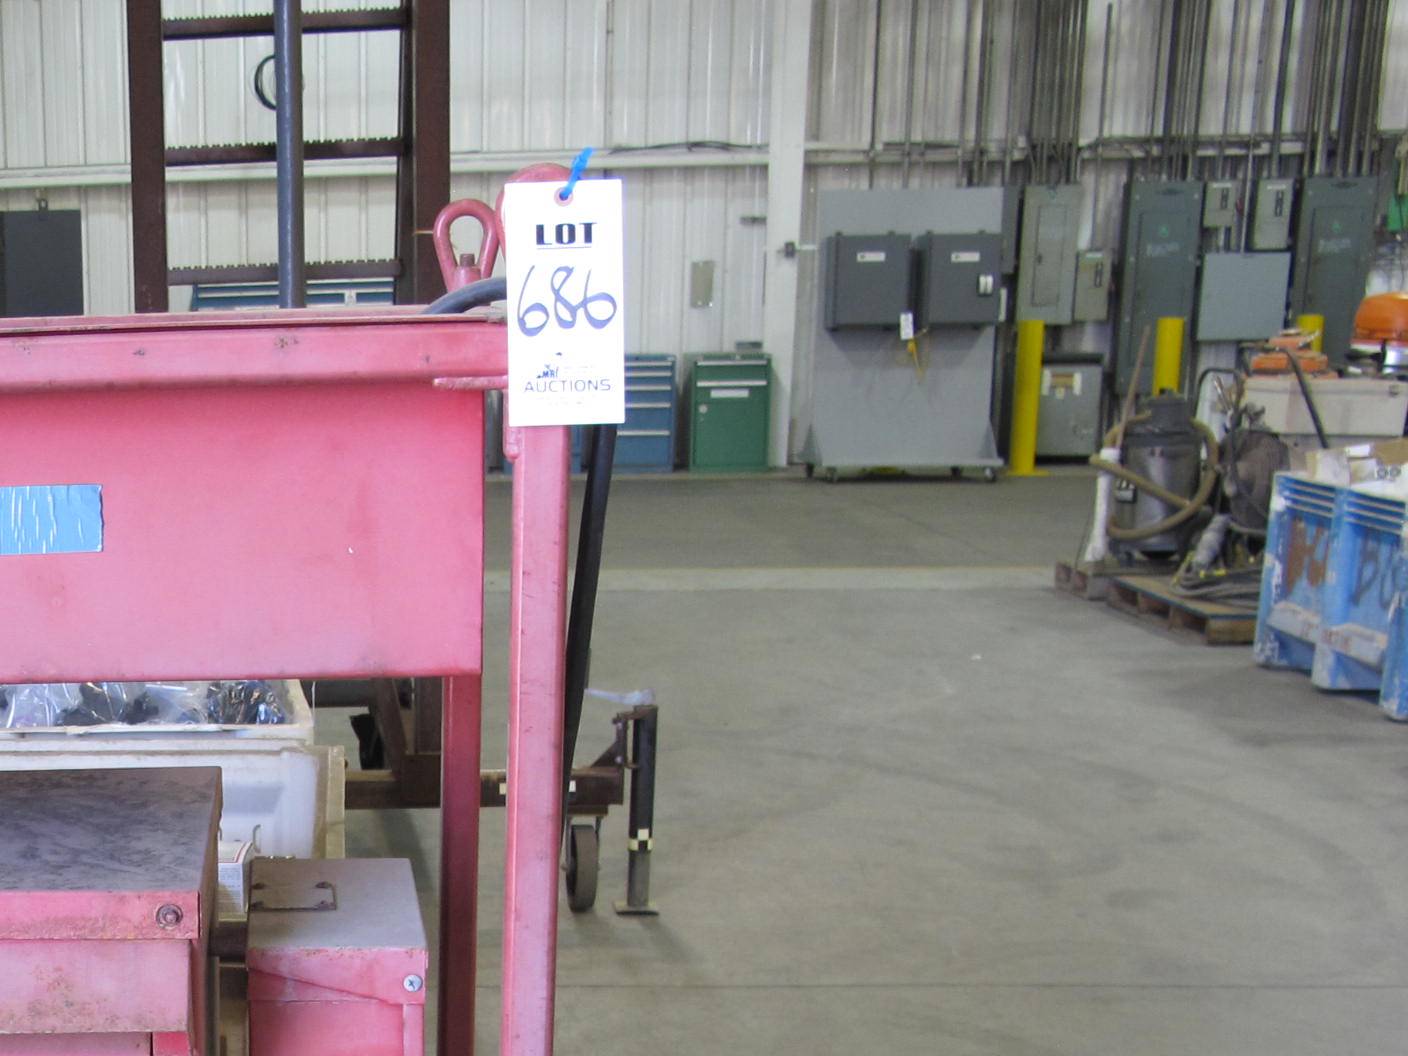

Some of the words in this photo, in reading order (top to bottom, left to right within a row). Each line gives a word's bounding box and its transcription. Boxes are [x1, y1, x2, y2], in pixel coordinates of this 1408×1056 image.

[535, 222, 597, 246] LOT
[517, 265, 617, 337] 686
[524, 378, 612, 393] AUCTIONS
